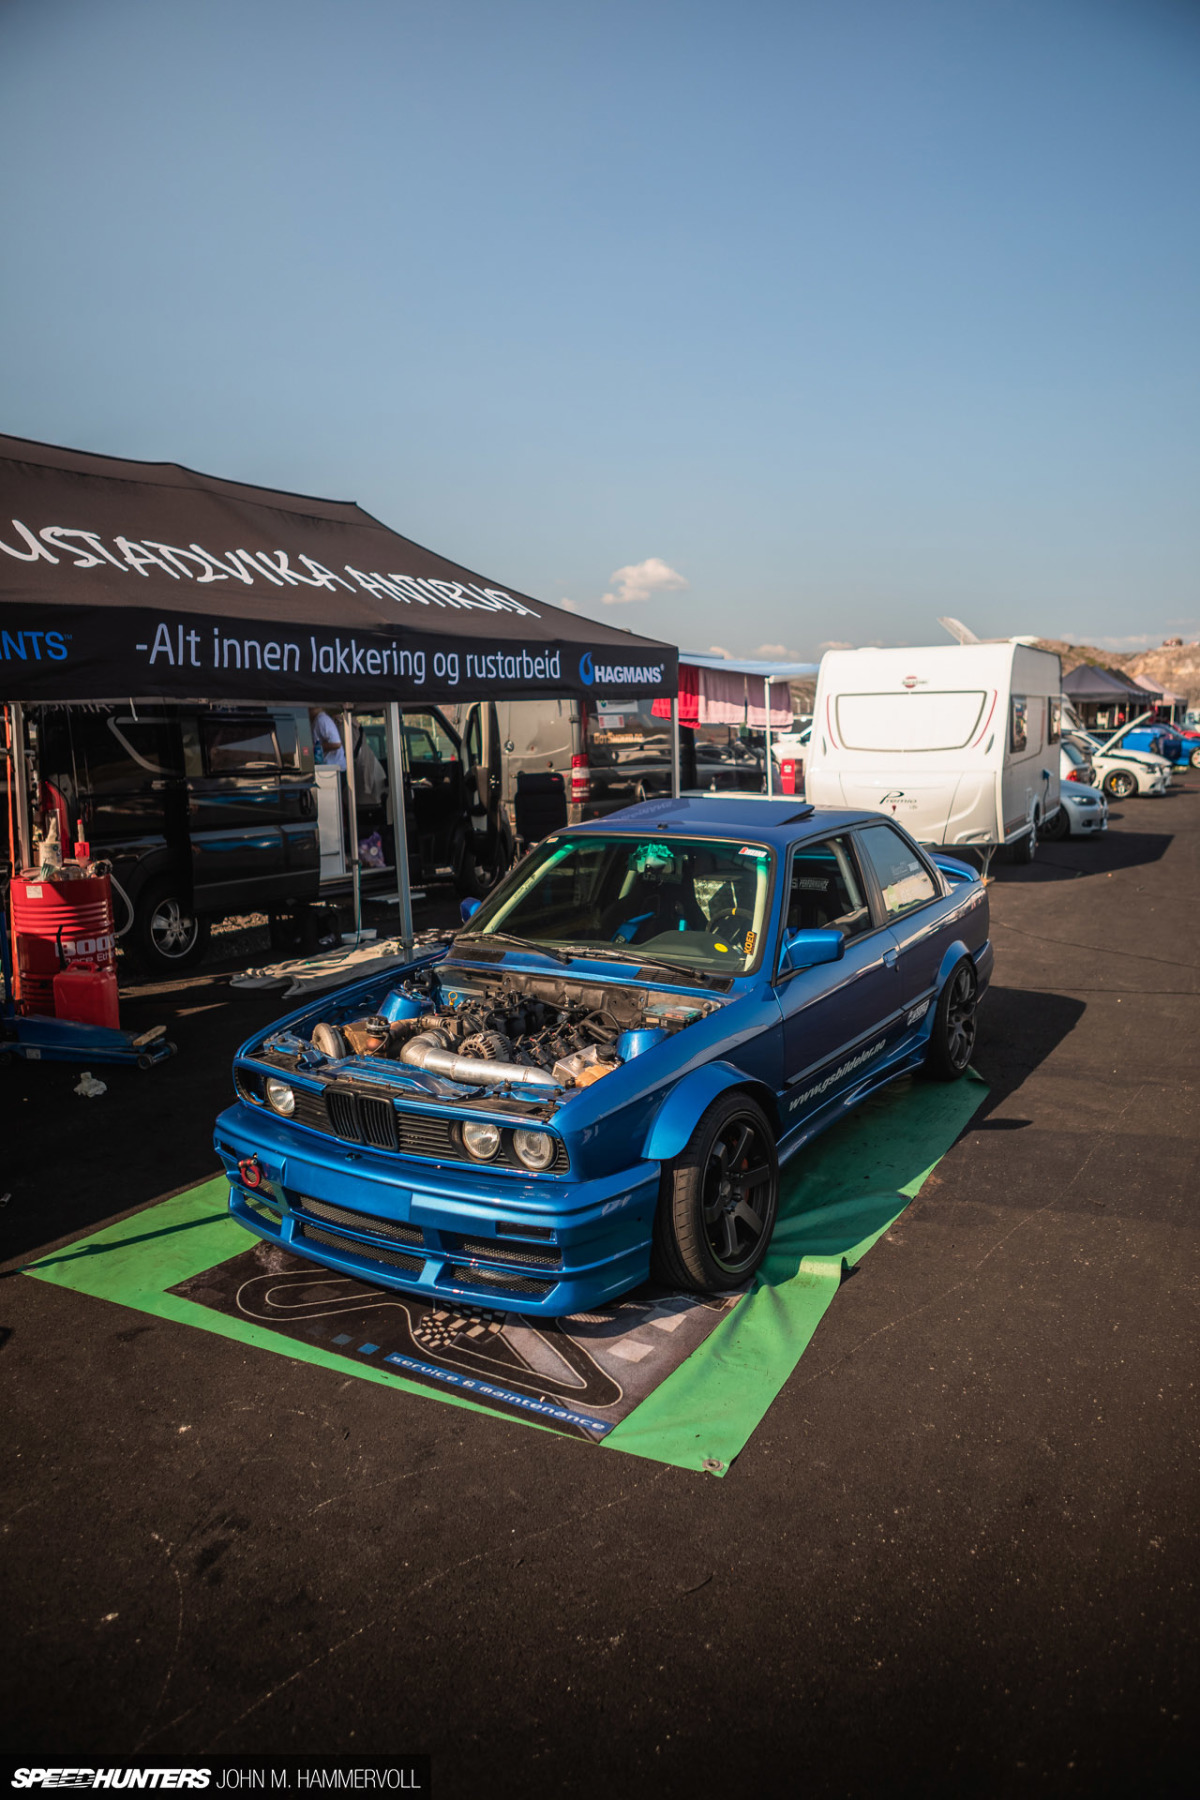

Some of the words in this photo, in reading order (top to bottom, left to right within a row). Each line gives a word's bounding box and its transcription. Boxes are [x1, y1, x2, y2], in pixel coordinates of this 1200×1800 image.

[0, 630, 68, 661] NTS
[136, 622, 202, 667] -Alt
[213, 628, 300, 672] innen
[311, 636, 426, 685] lakkering
[433, 651, 460, 685] og
[466, 649, 561, 679] rustarbeid
[594, 664, 662, 683] HAGMANS
[788, 1038, 886, 1112] www.gsbildeler.no
[390, 1356, 459, 1382] service
[479, 1384, 606, 1430] maintenance
